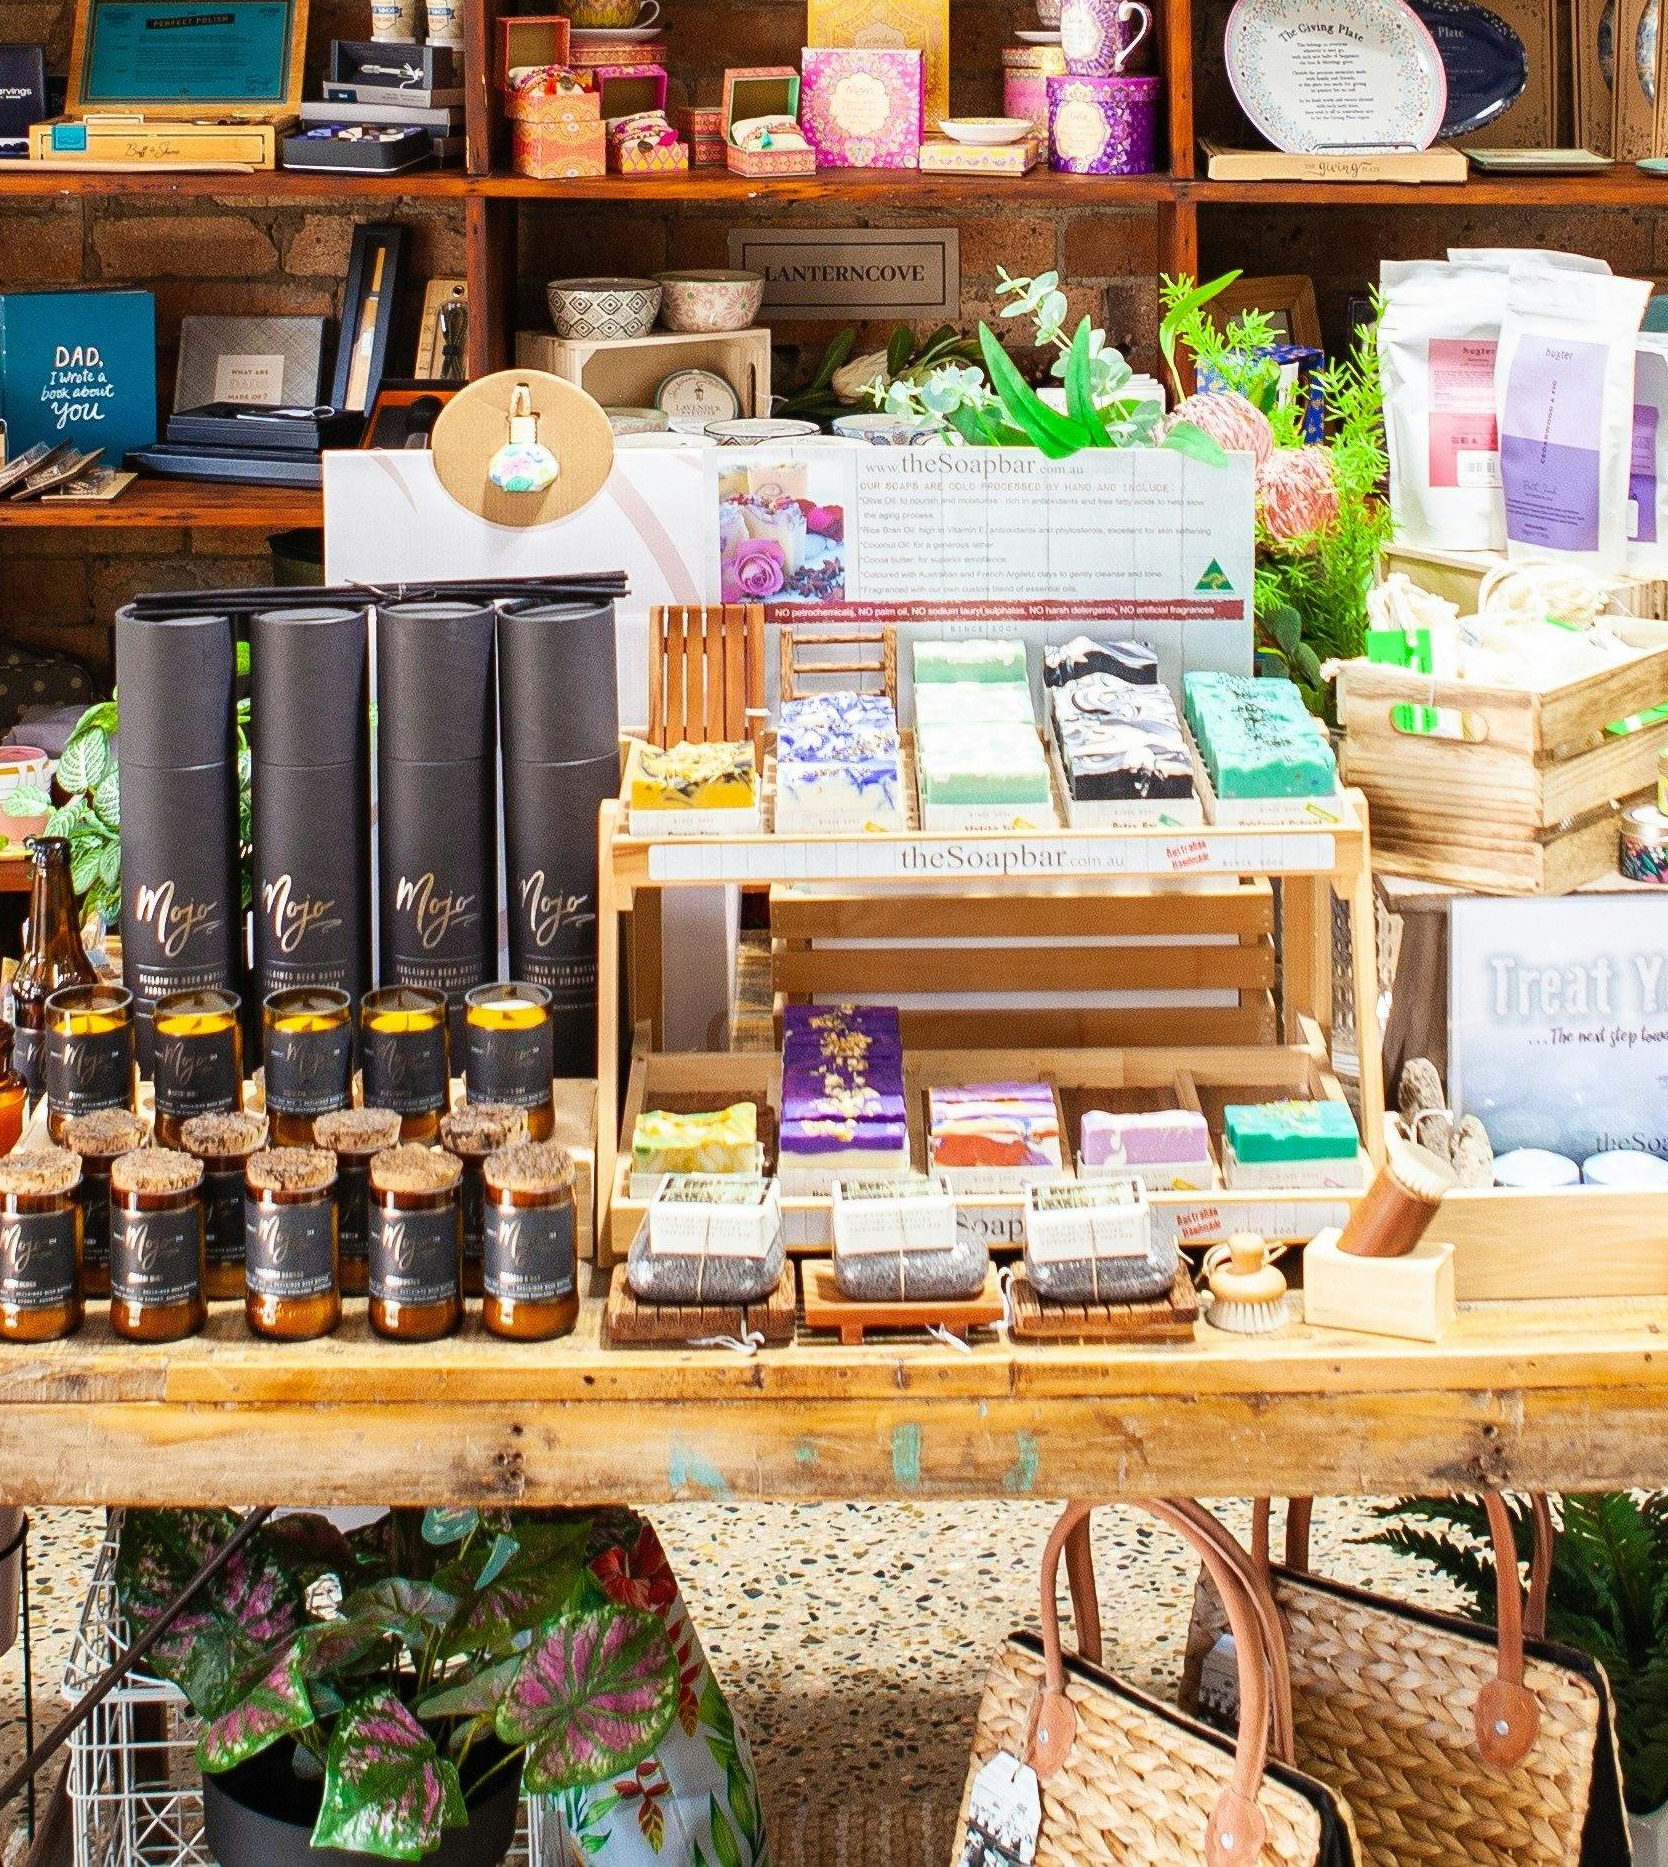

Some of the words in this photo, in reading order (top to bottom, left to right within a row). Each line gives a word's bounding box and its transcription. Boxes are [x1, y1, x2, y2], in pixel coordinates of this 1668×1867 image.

[1278, 27, 1297, 44] The
[1298, 22, 1335, 35] Giving
[1338, 23, 1364, 42] Plate
[1438, 27, 1465, 38] Plate
[1318, 161, 1360, 177] giving
[764, 264, 925, 283] LANTERNCOVE
[54, 345, 104, 368] DAD,
[59, 370, 94, 385] wrote
[98, 373, 107, 383] a
[40, 385, 70, 401] book
[72, 383, 114, 399] about
[860, 482, 880, 491] OUR
[885, 482, 919, 491] SOAPS
[924, 482, 943, 491] ARE
[949, 483, 975, 491] COLD
[981, 483, 1041, 491] PROCESSED
[1046, 483, 1059, 491] BY
[1065, 483, 1091, 492] HAND
[1097, 483, 1117, 492] AND
[775, 608, 789, 617] NO
[858, 608, 873, 617] NO
[875, 608, 896, 619] palm
[912, 608, 926, 616] NO
[1029, 607, 1044, 615] NO
[1045, 606, 1070, 615] harsh
[1120, 606, 1135, 614] NO
[136, 879, 219, 958] Mojo
[262, 873, 342, 954] Mojo
[396, 871, 479, 950] Mojo
[520, 868, 596, 948] Mojo
[1489, 954, 1615, 1018] Treat
[1578, 1027, 1606, 1043] next
[1609, 1026, 1638, 1048] step
